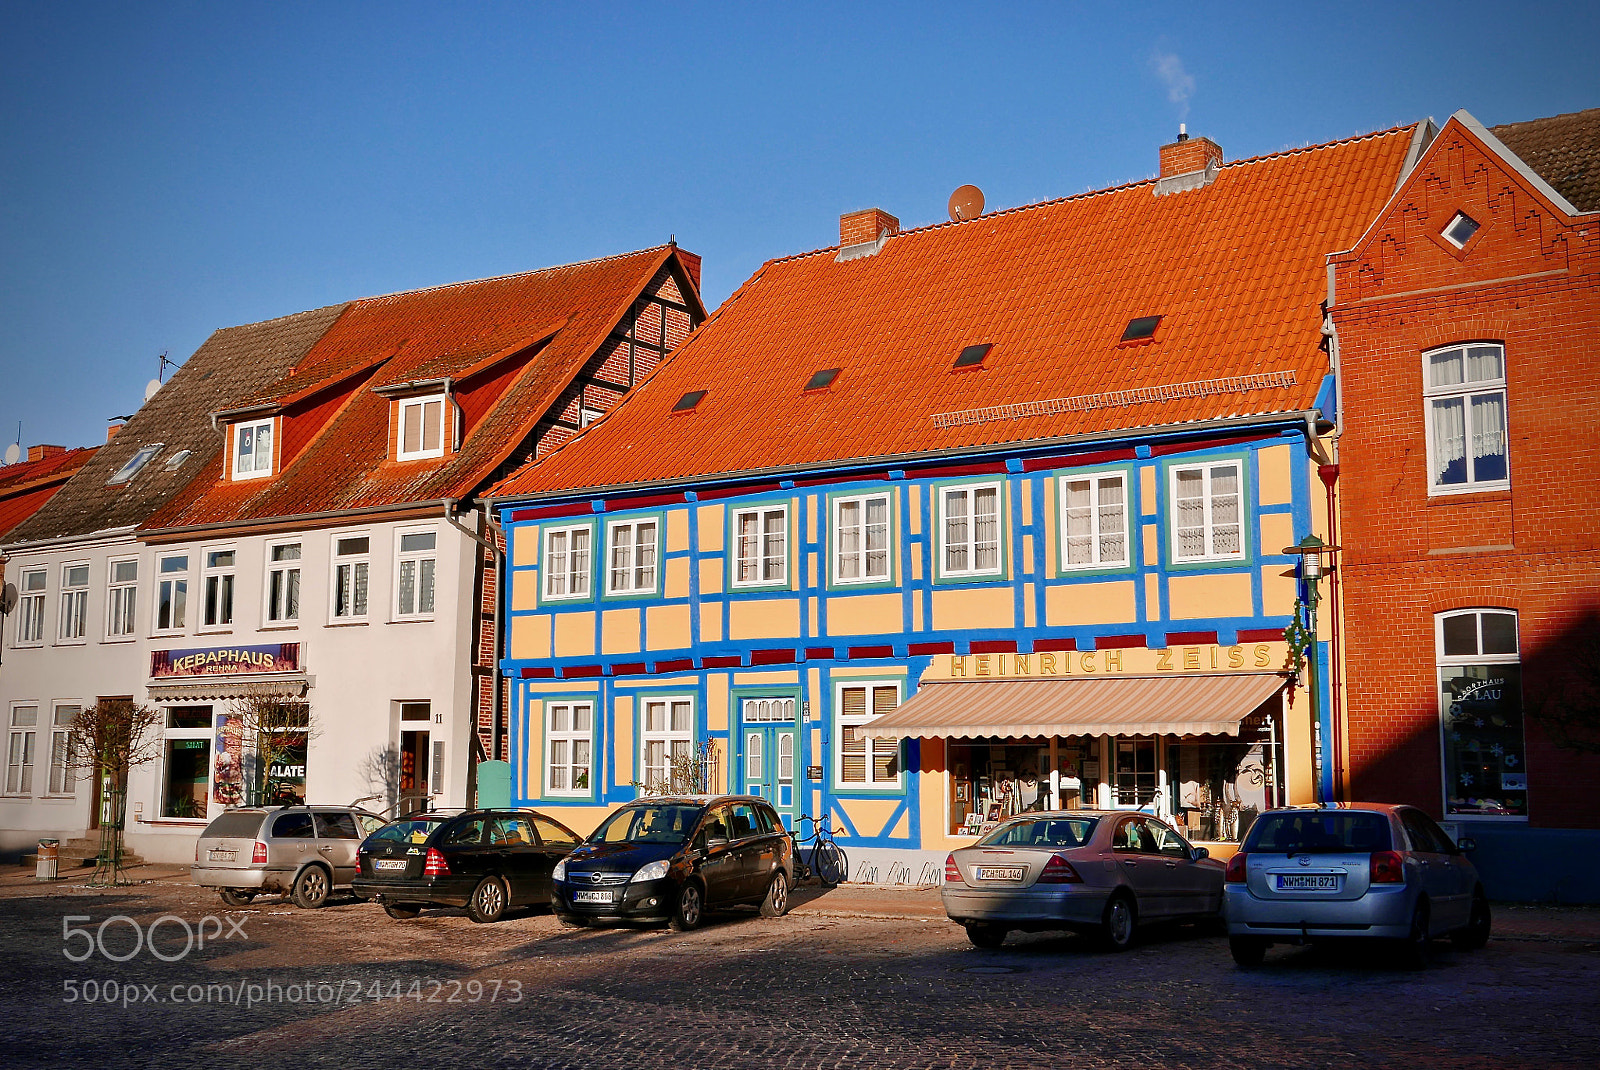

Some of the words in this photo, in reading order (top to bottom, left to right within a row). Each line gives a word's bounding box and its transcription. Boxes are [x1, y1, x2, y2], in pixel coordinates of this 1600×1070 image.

[173, 649, 274, 673] KEBAPHAUS
[951, 650, 1123, 677] HEINRICH
[1156, 644, 1271, 670] ZEISS
[206, 664, 238, 673] REHNA
[1457, 677, 1505, 702] SPORTHAUS
[434, 713, 443, 724] 11
[981, 869, 995, 879] PCH
[1008, 869, 1021, 879] 146
[1283, 876, 1300, 887] NWM
[1319, 876, 1336, 887] 871
